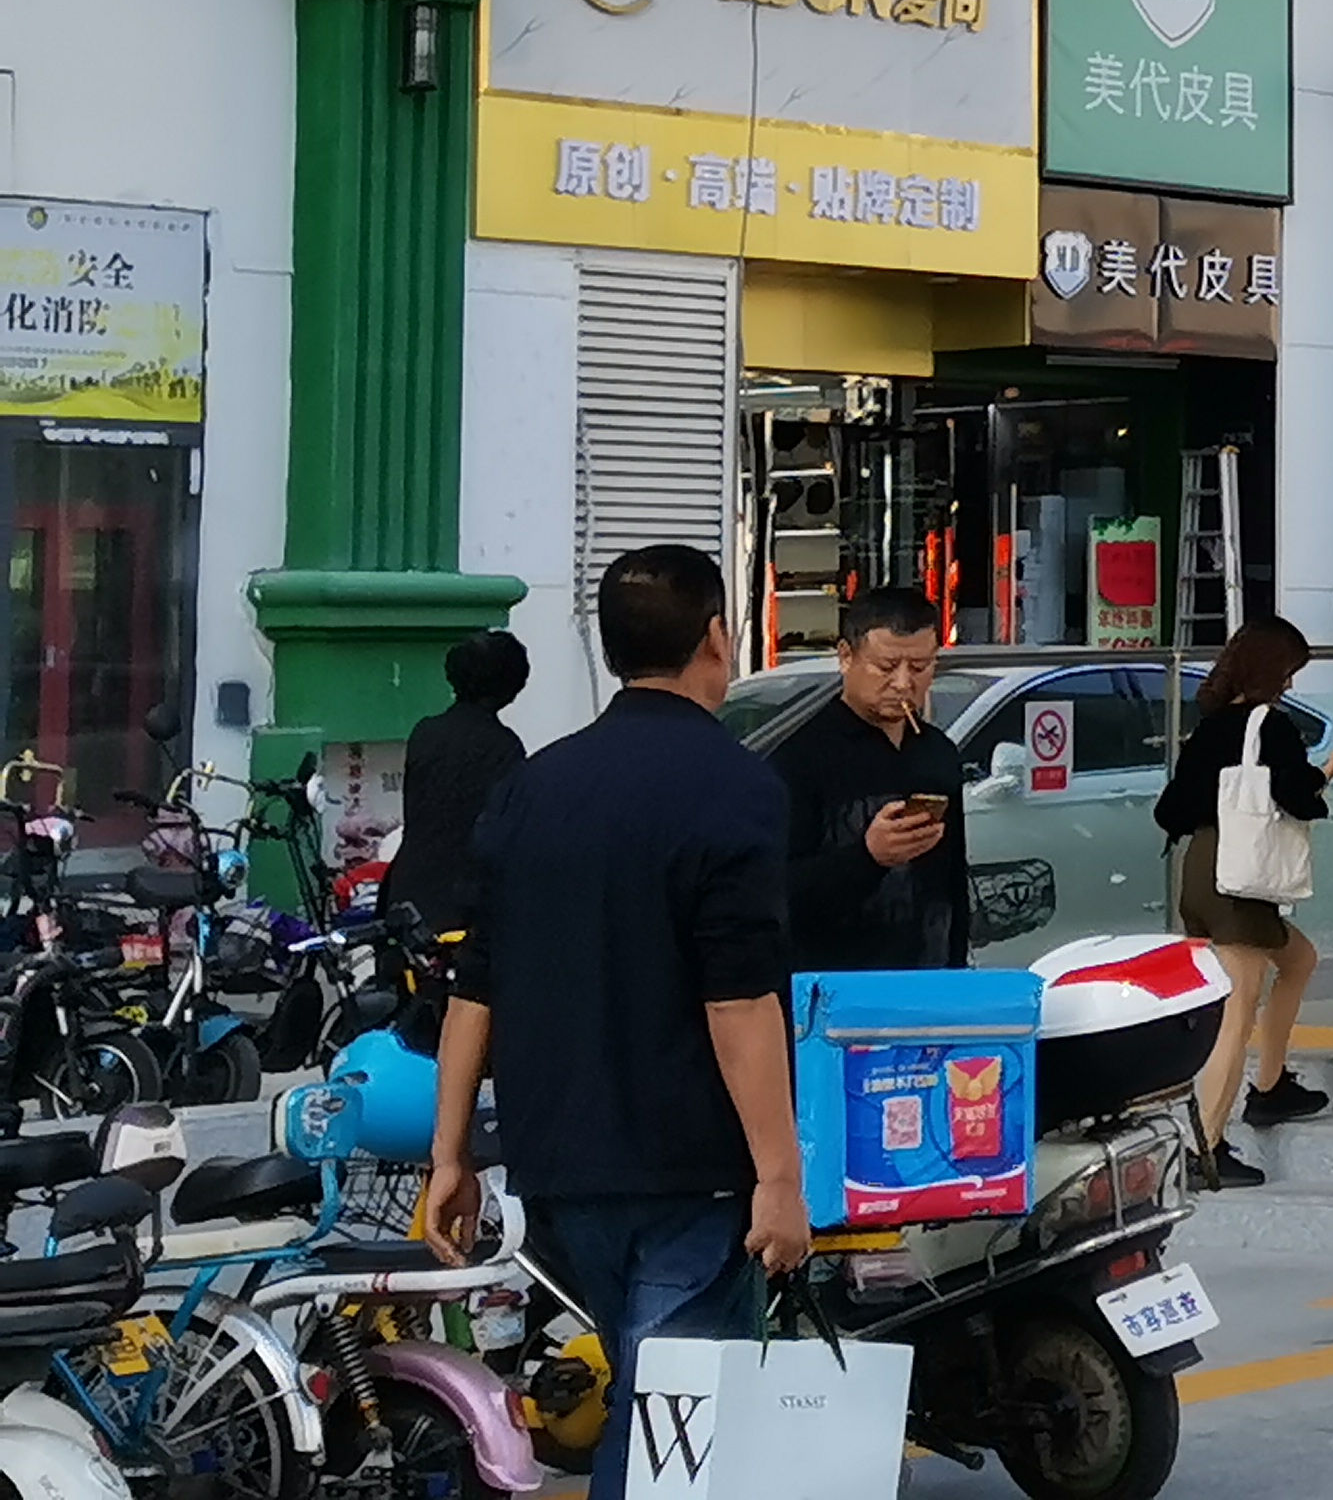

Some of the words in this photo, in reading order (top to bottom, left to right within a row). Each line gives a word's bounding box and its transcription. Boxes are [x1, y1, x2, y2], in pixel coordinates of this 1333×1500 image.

[1084, 50, 1258, 131] 美代皮具
[1100, 240, 1280, 306] 美代皮具
